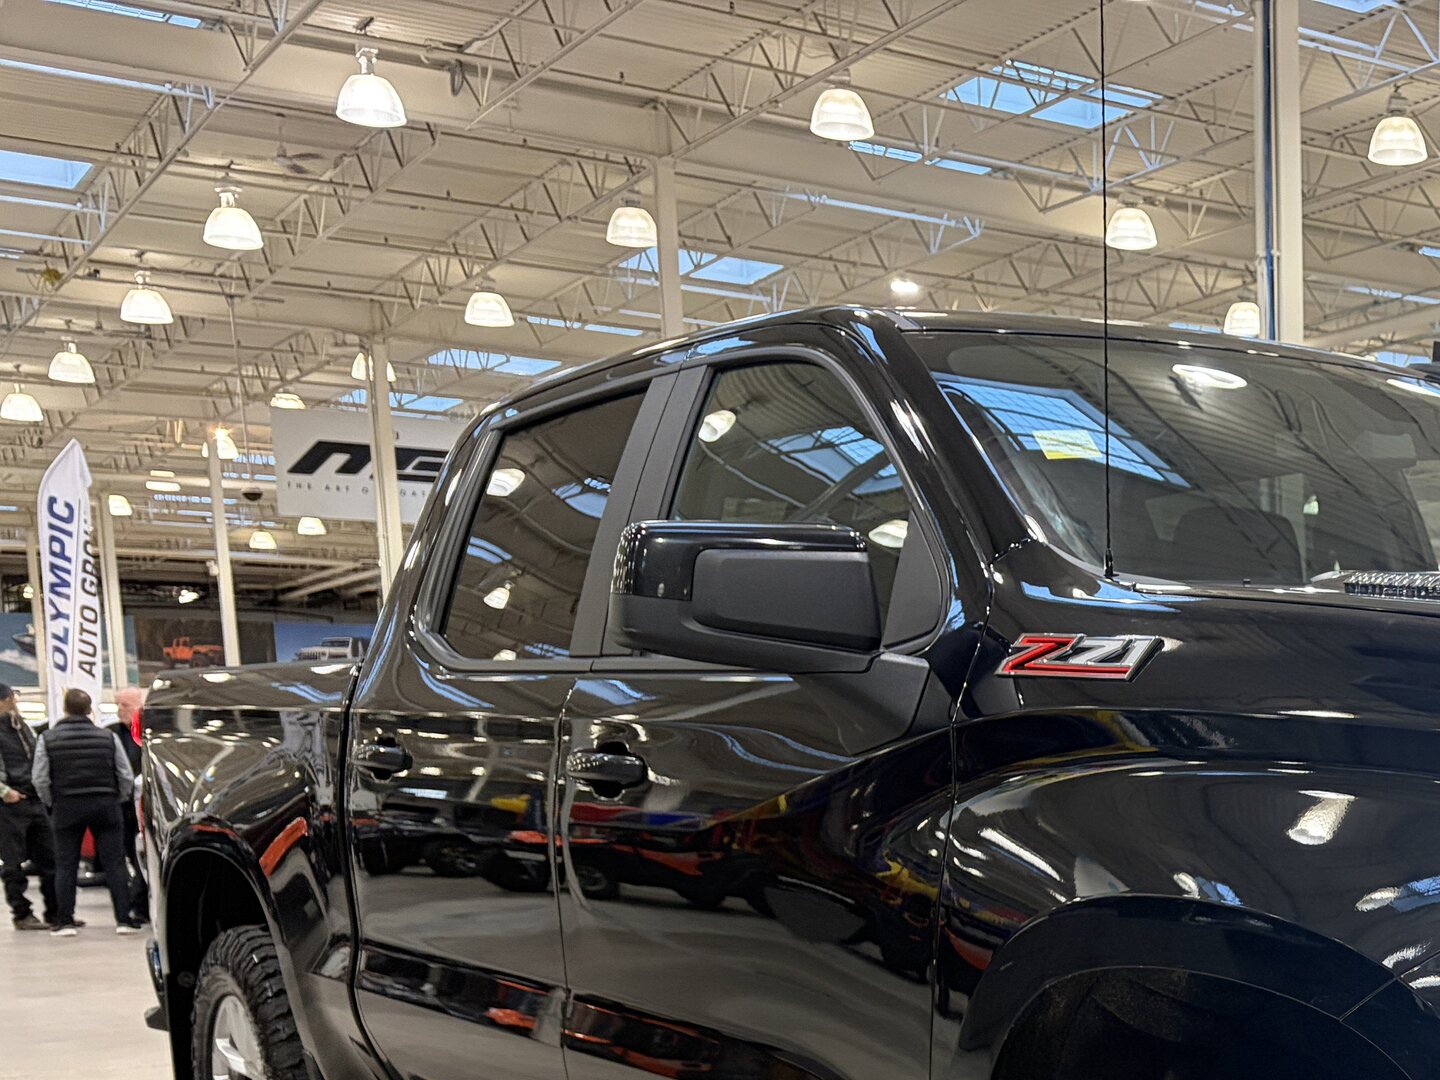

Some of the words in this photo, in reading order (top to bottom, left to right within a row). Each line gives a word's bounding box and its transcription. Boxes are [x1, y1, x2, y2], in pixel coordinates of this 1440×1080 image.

[47, 496, 75, 673] OLYMPIC
[78, 604, 98, 679] AUTO
[994, 633, 1163, 682] Z71
